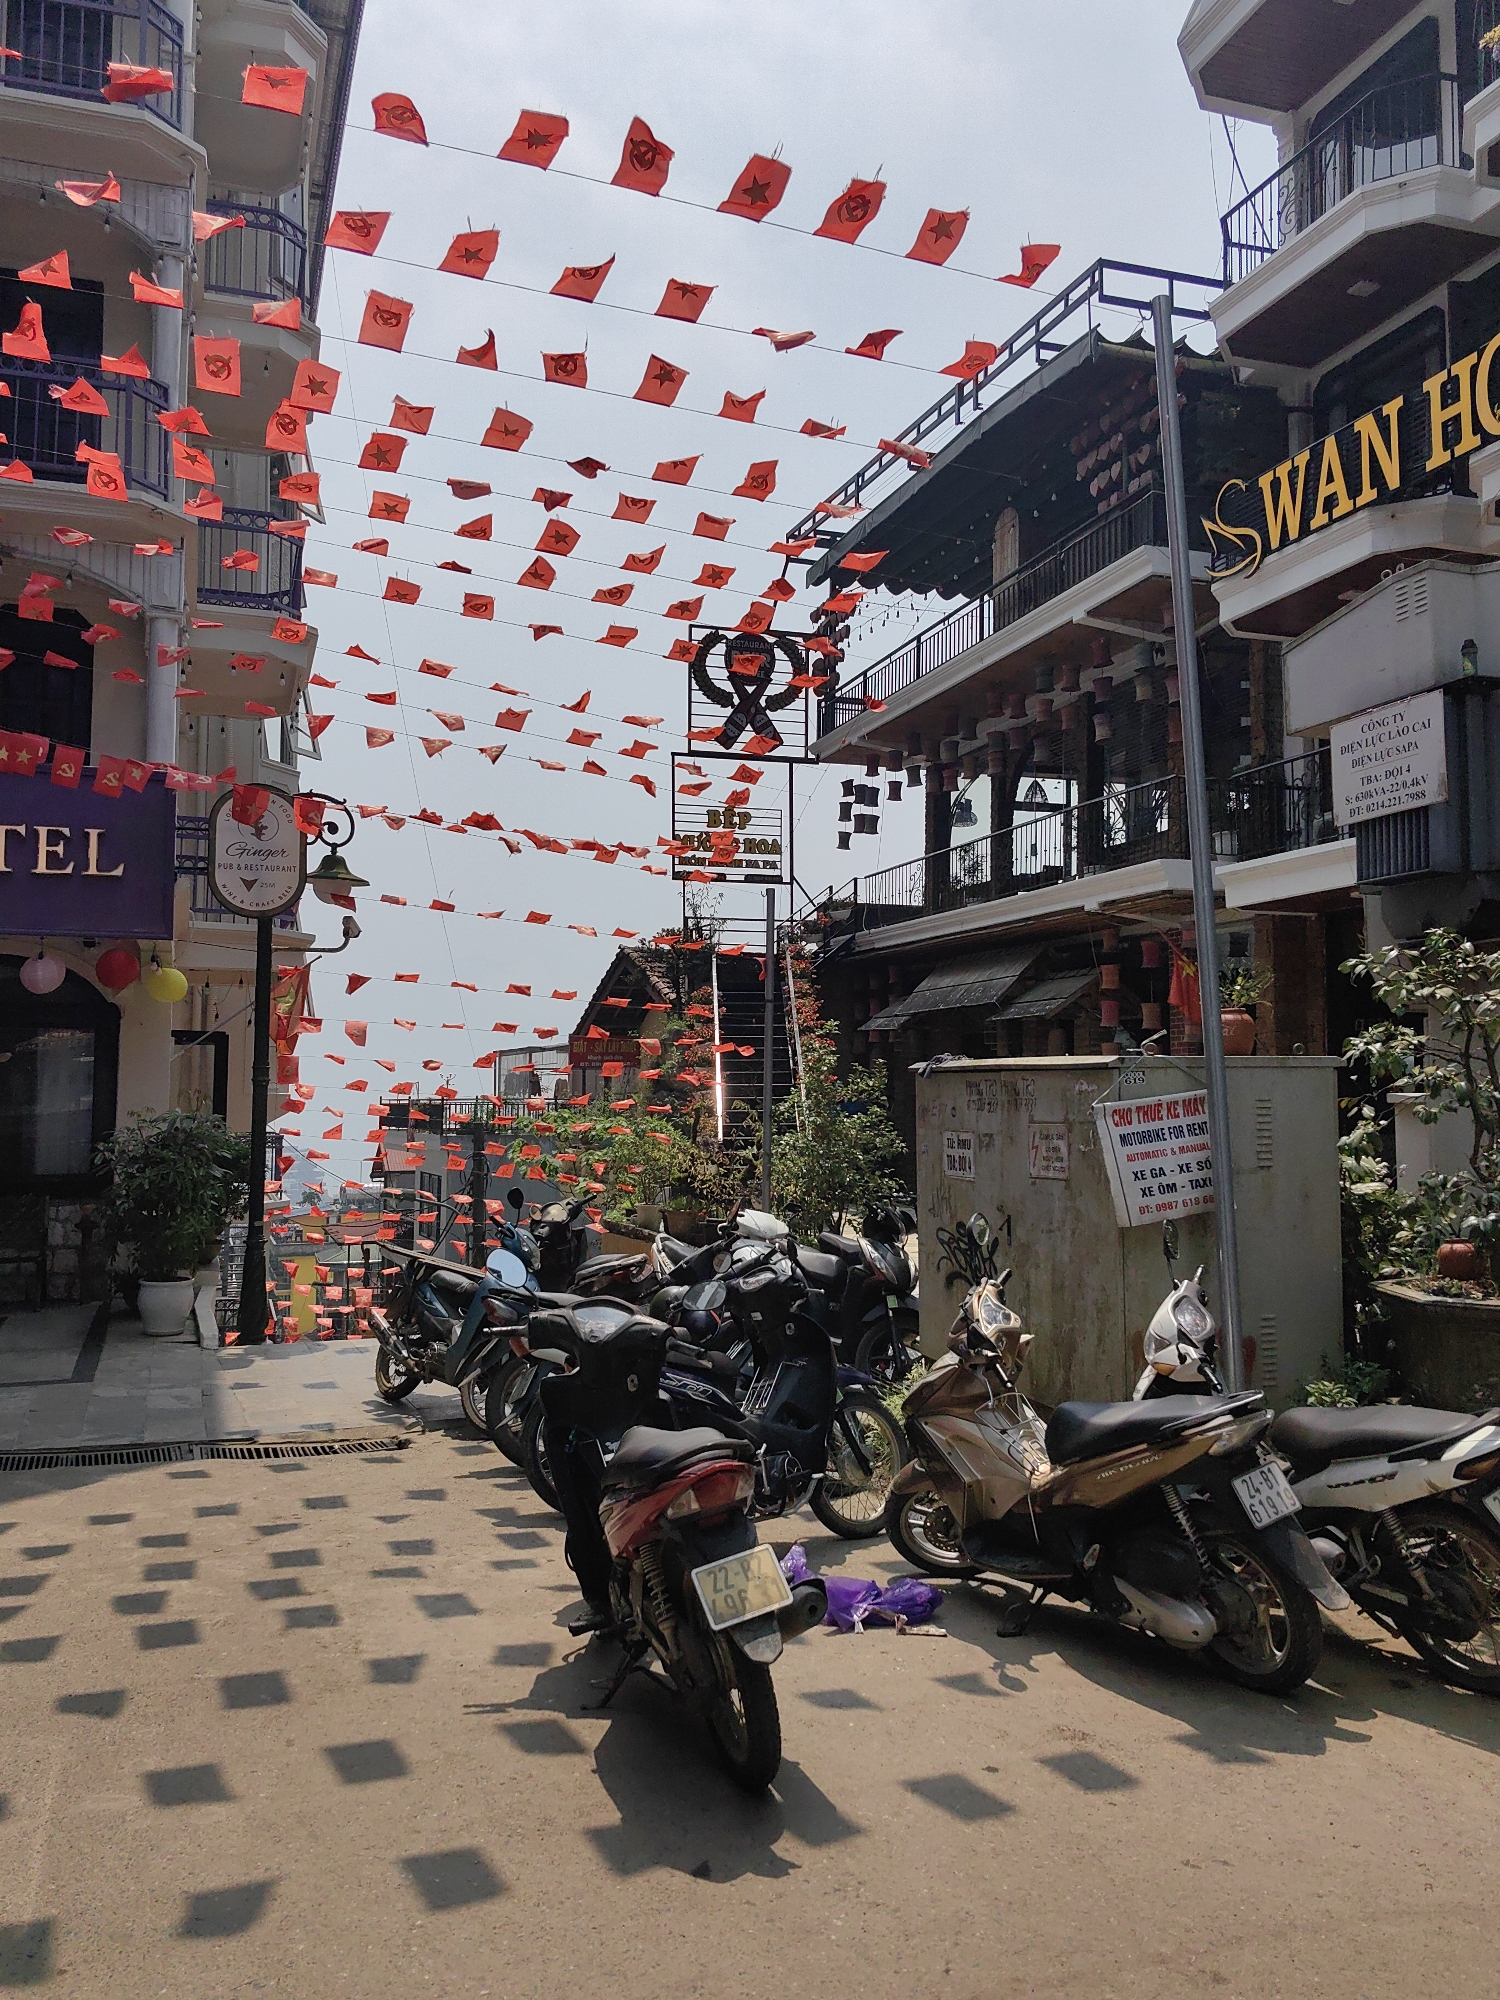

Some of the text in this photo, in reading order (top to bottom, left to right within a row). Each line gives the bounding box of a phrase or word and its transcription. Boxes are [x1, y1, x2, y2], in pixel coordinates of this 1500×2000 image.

[1200, 394, 1404, 579] SWAN
[727, 640, 774, 650] RESTAURANT
[1361, 710, 1406, 734] CÔNG TY
[1340, 718, 1432, 756] ĐIỆN LỰC LÀO CAI
[1351, 740, 1419, 769] ĐIỆN LỰC SAPA
[1360, 763, 1411, 787] TBA: ĐỘI 4
[1345, 795, 1353, 806] S:
[1350, 805, 1364, 818] ĐT:
[279, 804, 294, 824] FOOD
[225, 841, 290, 861] Ginger
[743, 838, 782, 855] HOA
[217, 862, 297, 873] PUB & RESTAURANT
[746, 860, 760, 868] SA
[762, 860, 779, 869] PA
[221, 882, 237, 901] WINE
[249, 898, 275, 907] CRAFT
[277, 885, 293, 901] BEER
[1124, 1077, 1145, 1085] 619
[1111, 1107, 1133, 1128] CHO
[1135, 1099, 1164, 1125] THUÊ
[1181, 1094, 1206, 1118] MÁY
[1119, 1121, 1209, 1148] MOTORBIKE FOR RENT
[1126, 1141, 1211, 1163] AUTOMATIC & MANUAL
[1132, 1169, 1148, 1182] XE
[1150, 1166, 1167, 1179] GA
[1177, 1162, 1193, 1175] XE
[1196, 1155, 1212, 1172] SỐ
[1140, 1186, 1156, 1199] XE
[1158, 1182, 1178, 1195] ÔM
[1188, 1177, 1213, 1190] TAXI
[1138, 1204, 1153, 1216] ĐT:
[1155, 1200, 1179, 1212] 0987
[1182, 1197, 1201, 1208] 618
[1241, 1466, 1280, 1499] 24-B1
[1248, 1486, 1297, 1524] 619.19
